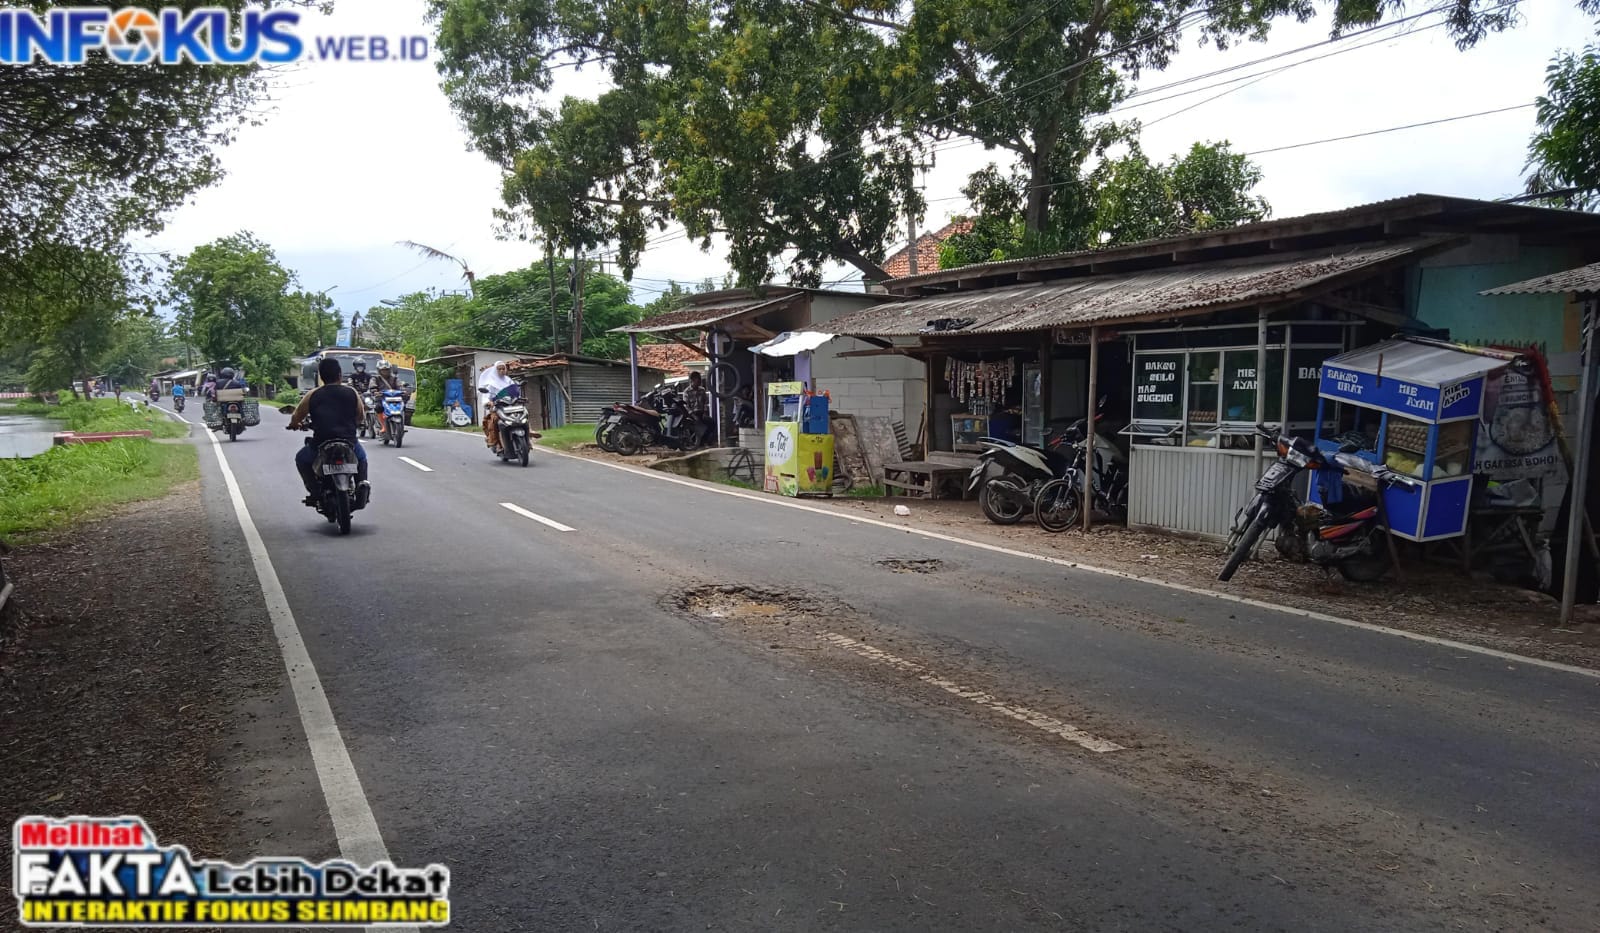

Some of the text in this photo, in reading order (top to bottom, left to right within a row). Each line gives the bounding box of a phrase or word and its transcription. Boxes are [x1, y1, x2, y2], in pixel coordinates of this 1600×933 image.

[1145, 361, 1176, 371] BAKSO
[1149, 372, 1175, 382] SOLO
[1237, 368, 1256, 378] MIE
[1327, 369, 1359, 383] BAKSO
[1137, 384, 1157, 394] MAS
[1337, 381, 1364, 395] URAT
[1398, 384, 1418, 397] MIE
[1444, 384, 1461, 397] MIE
[1137, 393, 1174, 403] SUGENG
[1406, 397, 1434, 411] AYAM
[1443, 388, 1469, 407] AYAM
